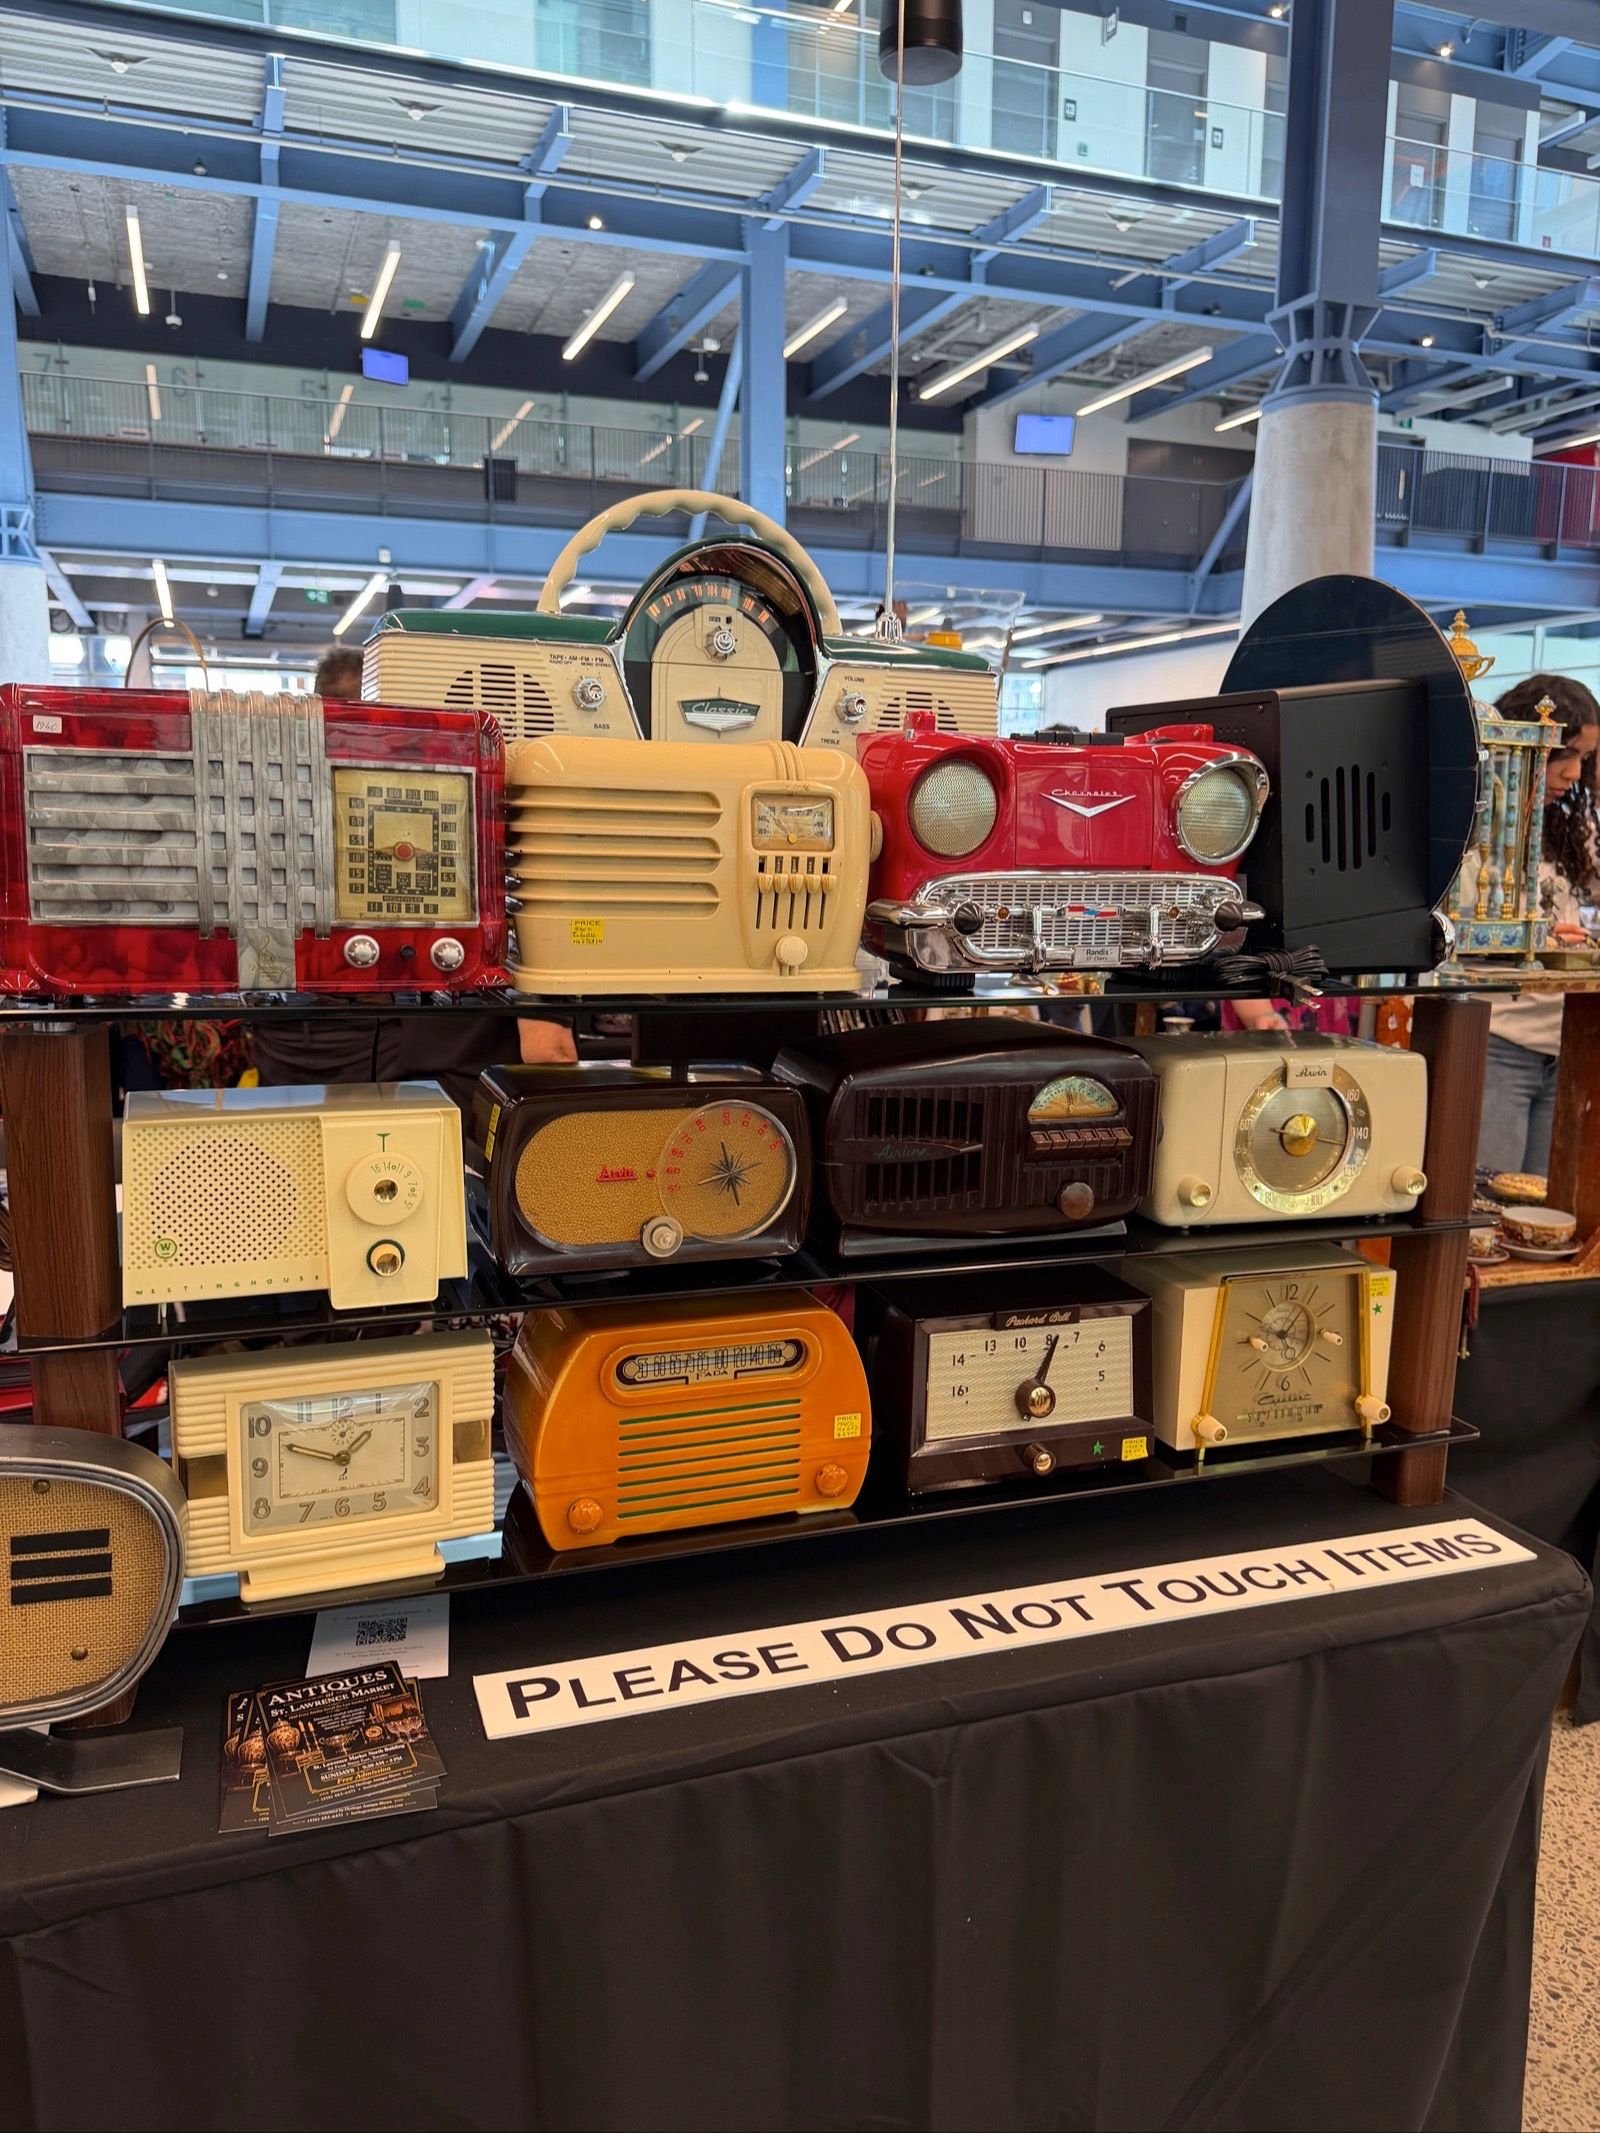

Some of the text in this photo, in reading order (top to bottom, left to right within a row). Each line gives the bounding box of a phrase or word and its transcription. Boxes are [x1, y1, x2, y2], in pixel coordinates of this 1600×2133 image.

[171, 366, 188, 397] 6
[844, 675, 865, 683] VOLUME
[691, 702, 748, 715] Classic
[351, 869, 362, 878] 15
[351, 884, 362, 893] 13
[369, 902, 379, 912] 11
[1295, 1066, 1328, 1078] Arvin
[371, 1163, 382, 1174] 16
[383, 1161, 391, 1171] 14
[666, 1166, 681, 1175] 60
[1286, 1284, 1299, 1300] 12
[1006, 1311, 1072, 1327] Packard Bell
[1014, 1337, 1027, 1348] 10
[1045, 1334, 1053, 1345] 8
[1073, 1332, 1080, 1343] 7
[985, 1340, 997, 1351] 13
[1098, 1340, 1106, 1351] 6
[654, 1355, 666, 1377] 60
[670, 1353, 682, 1375] 65
[714, 1349, 729, 1370] 100
[734, 1347, 747, 1369] 120
[750, 1345, 765, 1366] 140
[767, 1343, 782, 1365] 165
[952, 1354, 965, 1367] 14
[696, 1369, 728, 1381] FADA
[1098, 1370, 1105, 1381] 5
[1281, 1375, 1291, 1391] 6
[952, 1385, 964, 1397] 16
[297, 1392, 430, 1423] 11 12 1 2
[248, 1415, 272, 1439] 10
[414, 1436, 430, 1457] 3
[252, 1457, 268, 1478] 9
[413, 1476, 431, 1496] 4
[253, 1491, 387, 1523] 8 7 6 5
[505, 1533, 1502, 1720] PLEASE DO NOT TOUCH ITEMS
[268, 1670, 388, 1706] ANTIQUES
[348, 1752, 367, 1760] Market
[320, 1768, 355, 1781] SUNDAYS
[337, 1775, 354, 1785] Free
[355, 1766, 392, 1780] Admission
